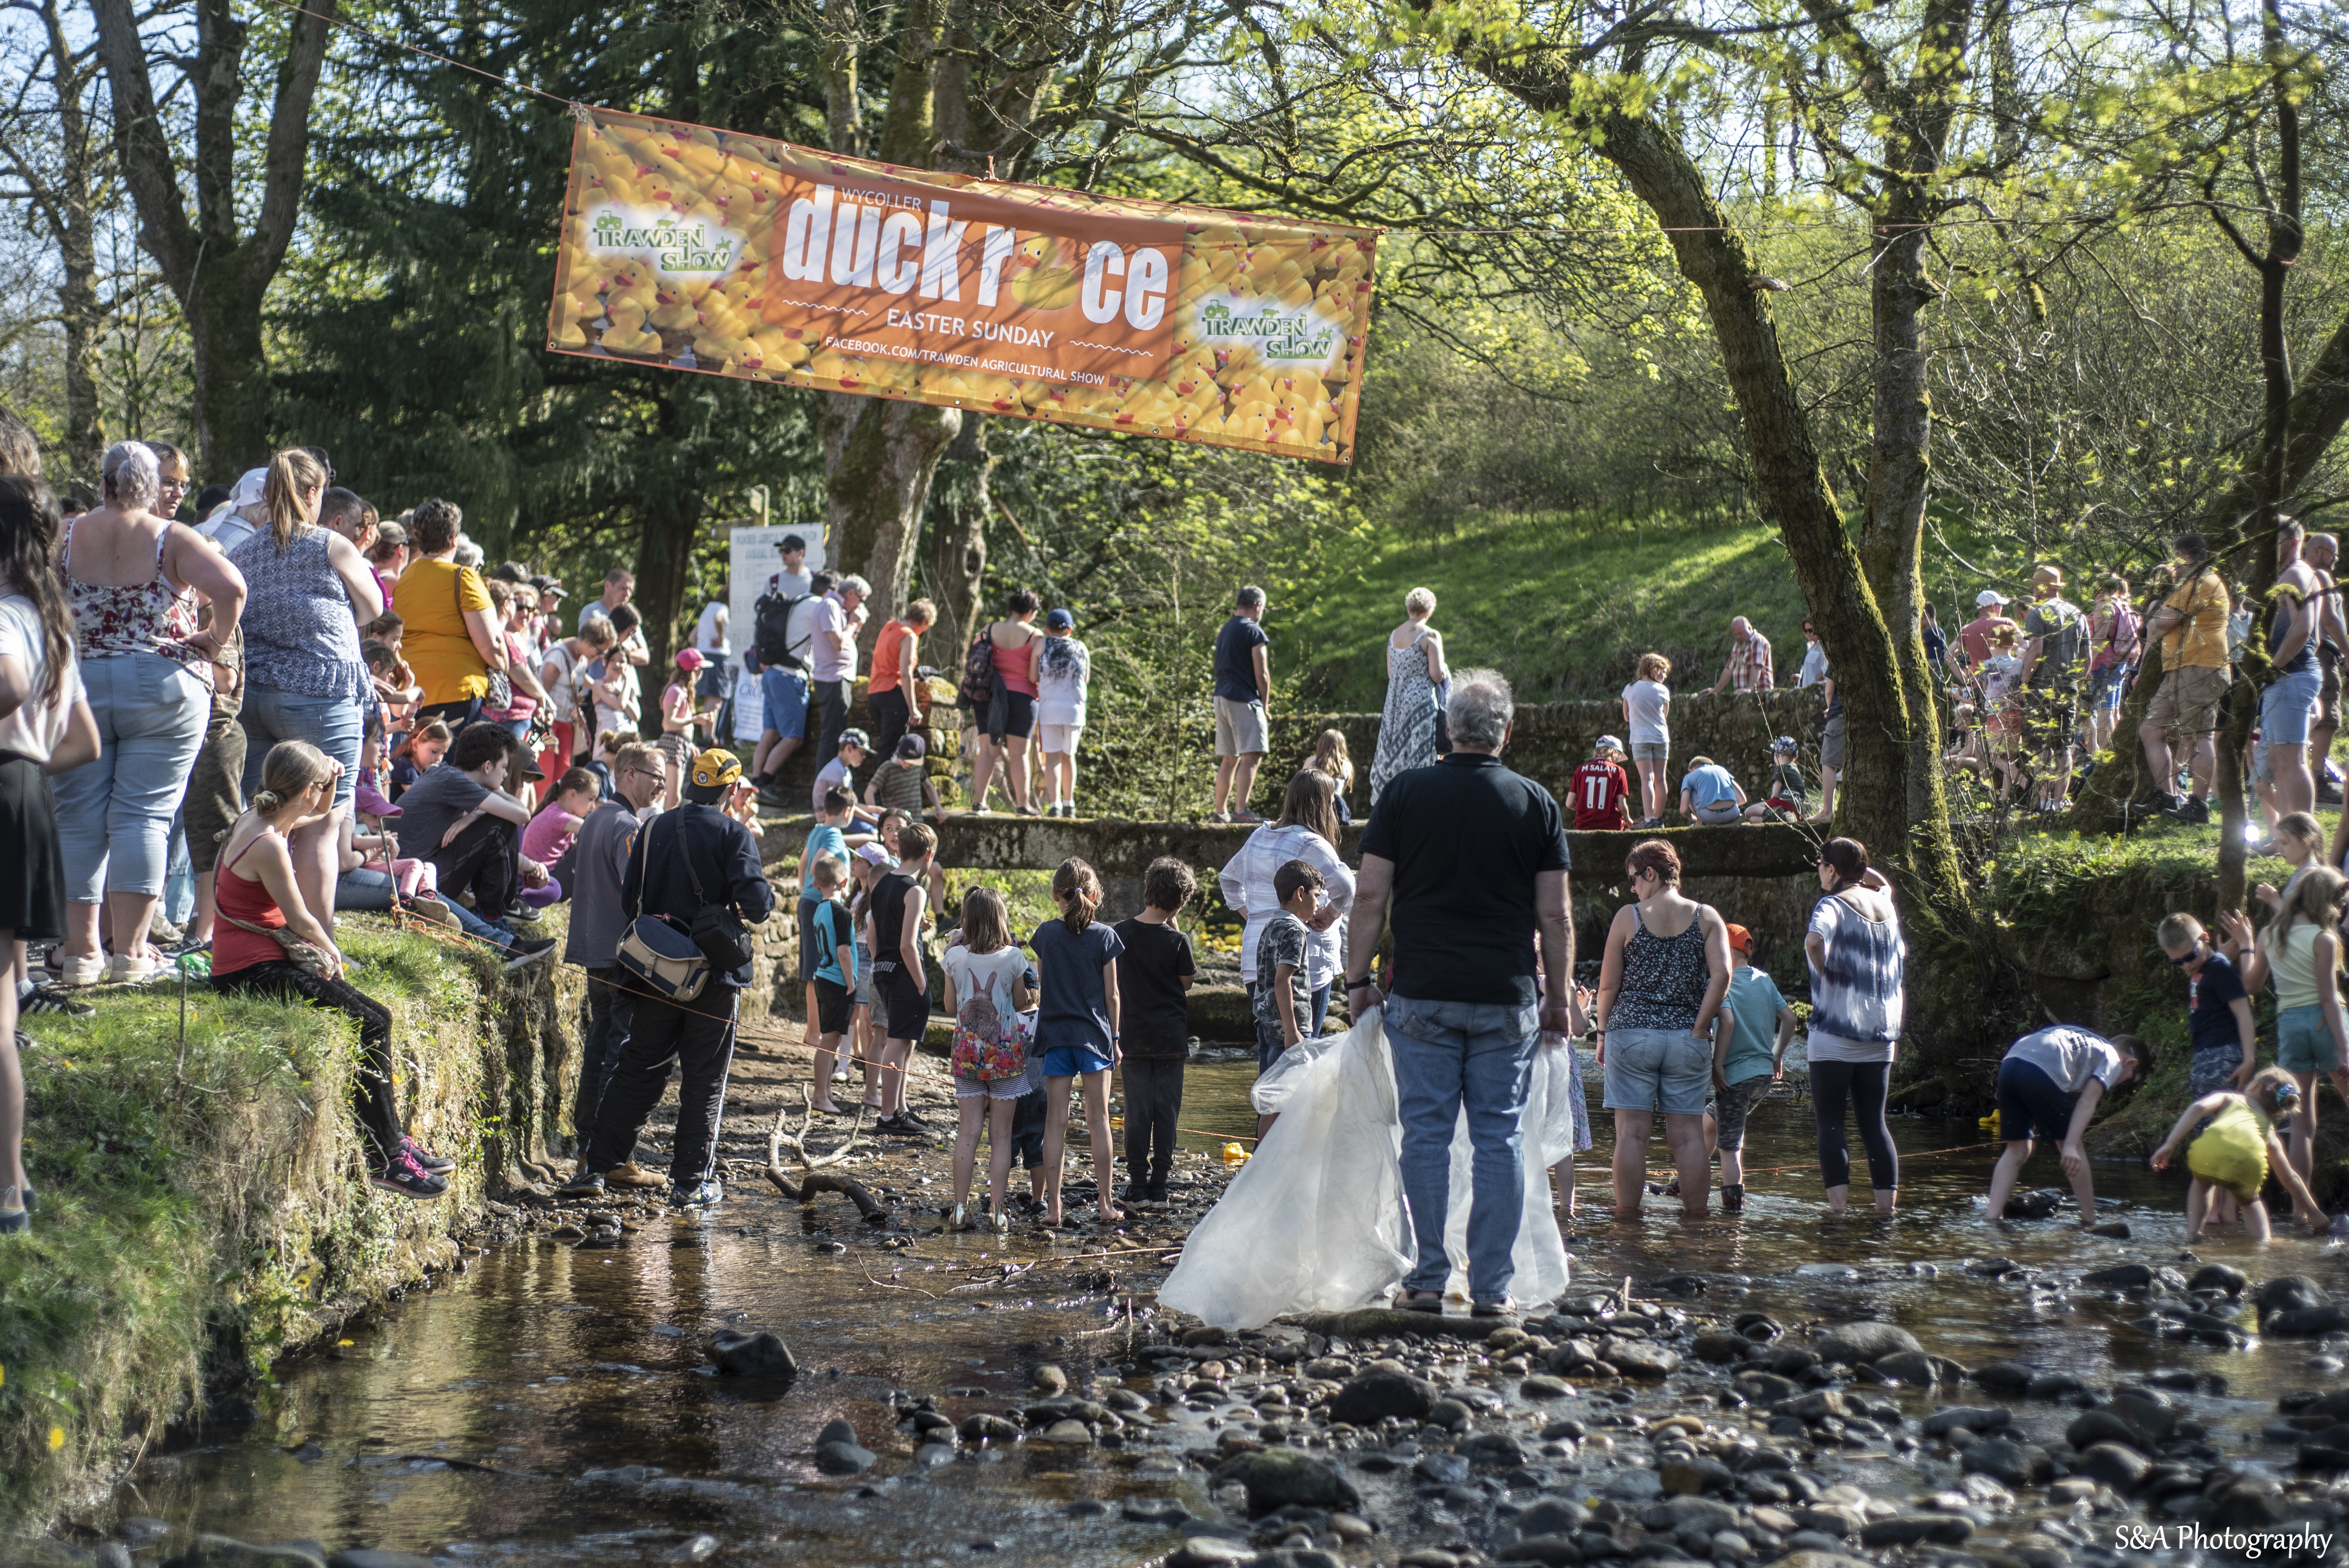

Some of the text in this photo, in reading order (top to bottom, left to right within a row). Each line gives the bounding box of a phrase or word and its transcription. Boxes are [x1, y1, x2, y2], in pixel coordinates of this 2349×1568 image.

[841, 187, 921, 211] WYCOLLER
[593, 228, 704, 248] TRAWDEN
[660, 248, 732, 271] SHOW
[782, 184, 1169, 331] duck rce
[887, 308, 1055, 348] EASTER SUNDAY
[1202, 317, 1307, 336] TRAWDEN
[1266, 336, 1333, 359] SHOW
[825, 336, 1105, 385] FACEBOOK.COM/TRAWDEN AGRICULTURAL SHOW
[1585, 776, 1608, 810] 11
